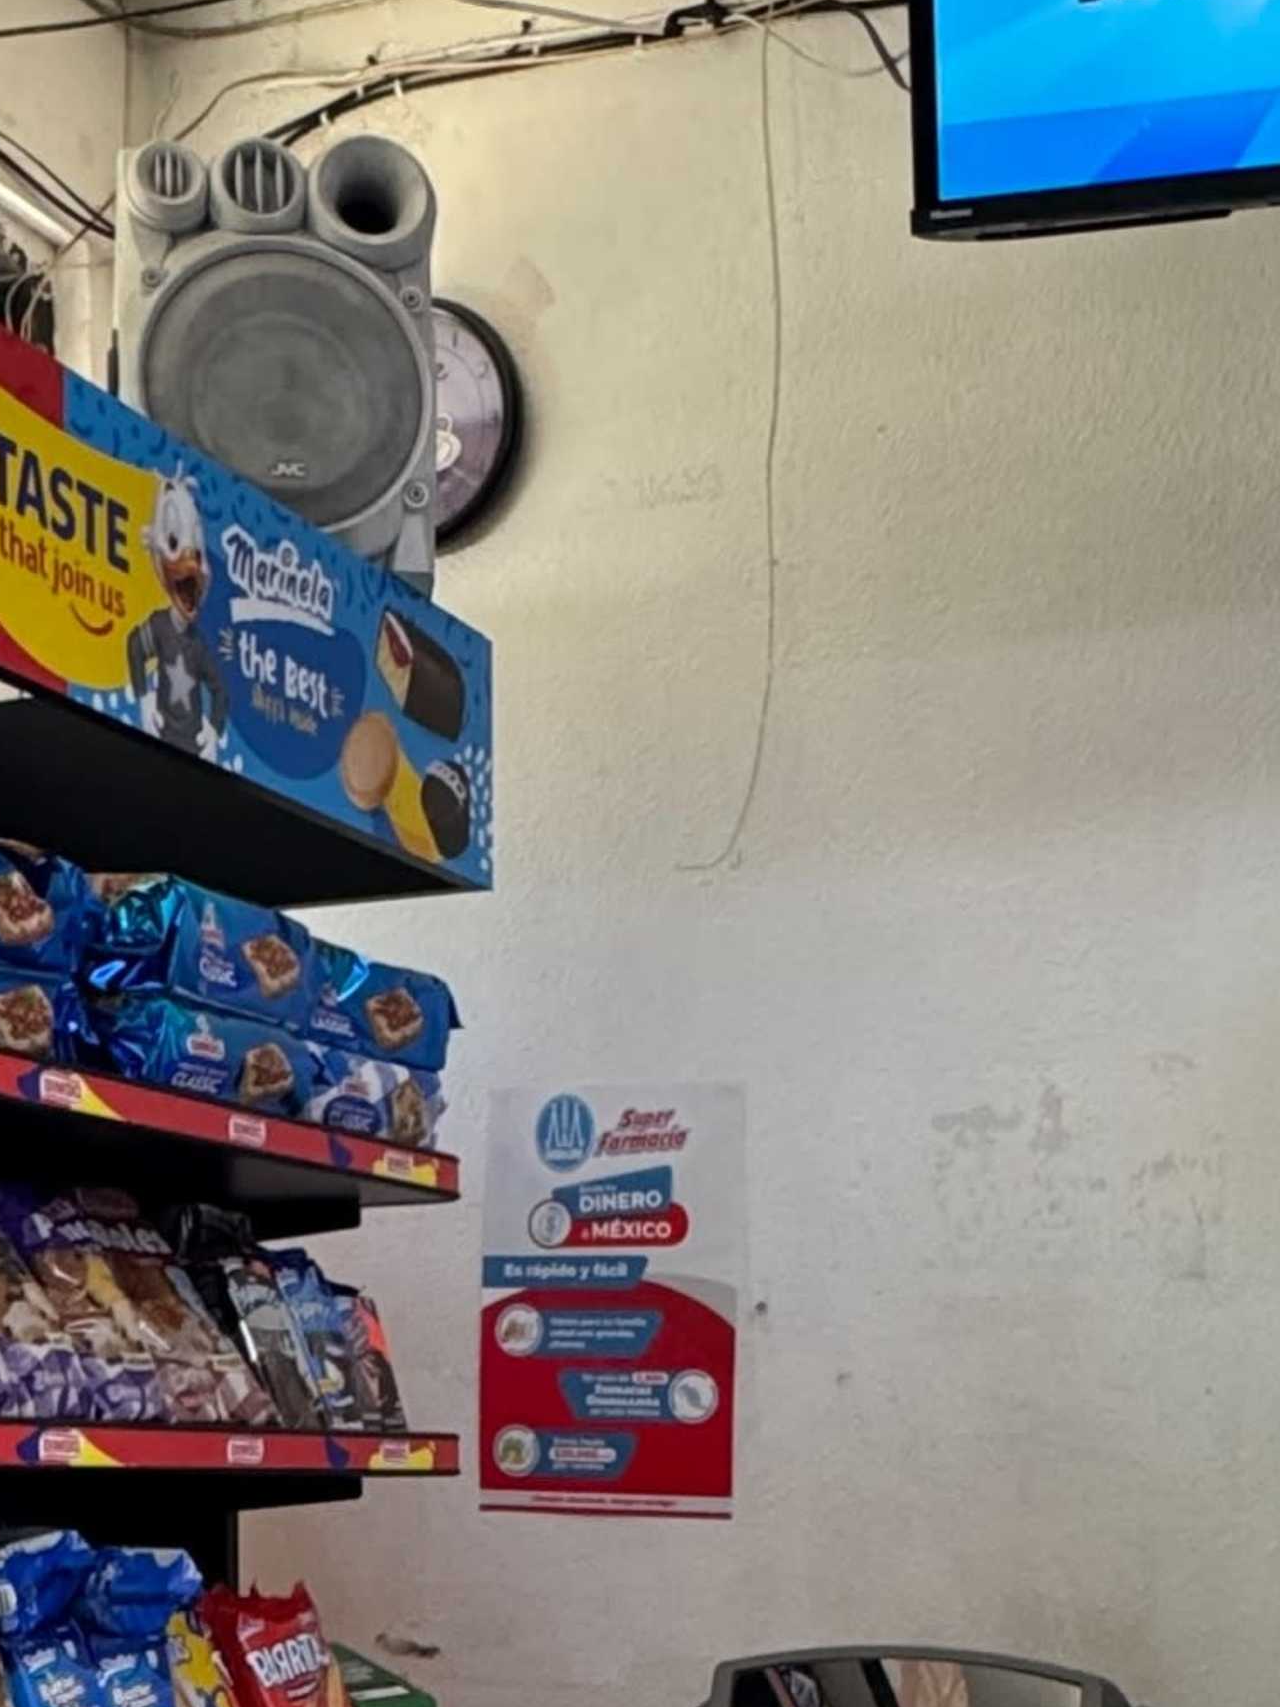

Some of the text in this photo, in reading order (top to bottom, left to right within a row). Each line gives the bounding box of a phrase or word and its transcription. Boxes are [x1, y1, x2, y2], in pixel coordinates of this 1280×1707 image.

[271, 461, 307, 479] JVC
[50, 546, 99, 605] join
[99, 580, 127, 619] us
[225, 531, 333, 615] Marinela
[238, 629, 278, 685] the
[616, 1108, 677, 1133] Super
[595, 1125, 691, 1158] Farmacia
[578, 1192, 663, 1213] DINERO
[591, 1218, 672, 1240] MÉXICO
[503, 1263, 521, 1278] Es
[525, 1262, 577, 1281] rápido
[590, 1261, 628, 1279] fácil
